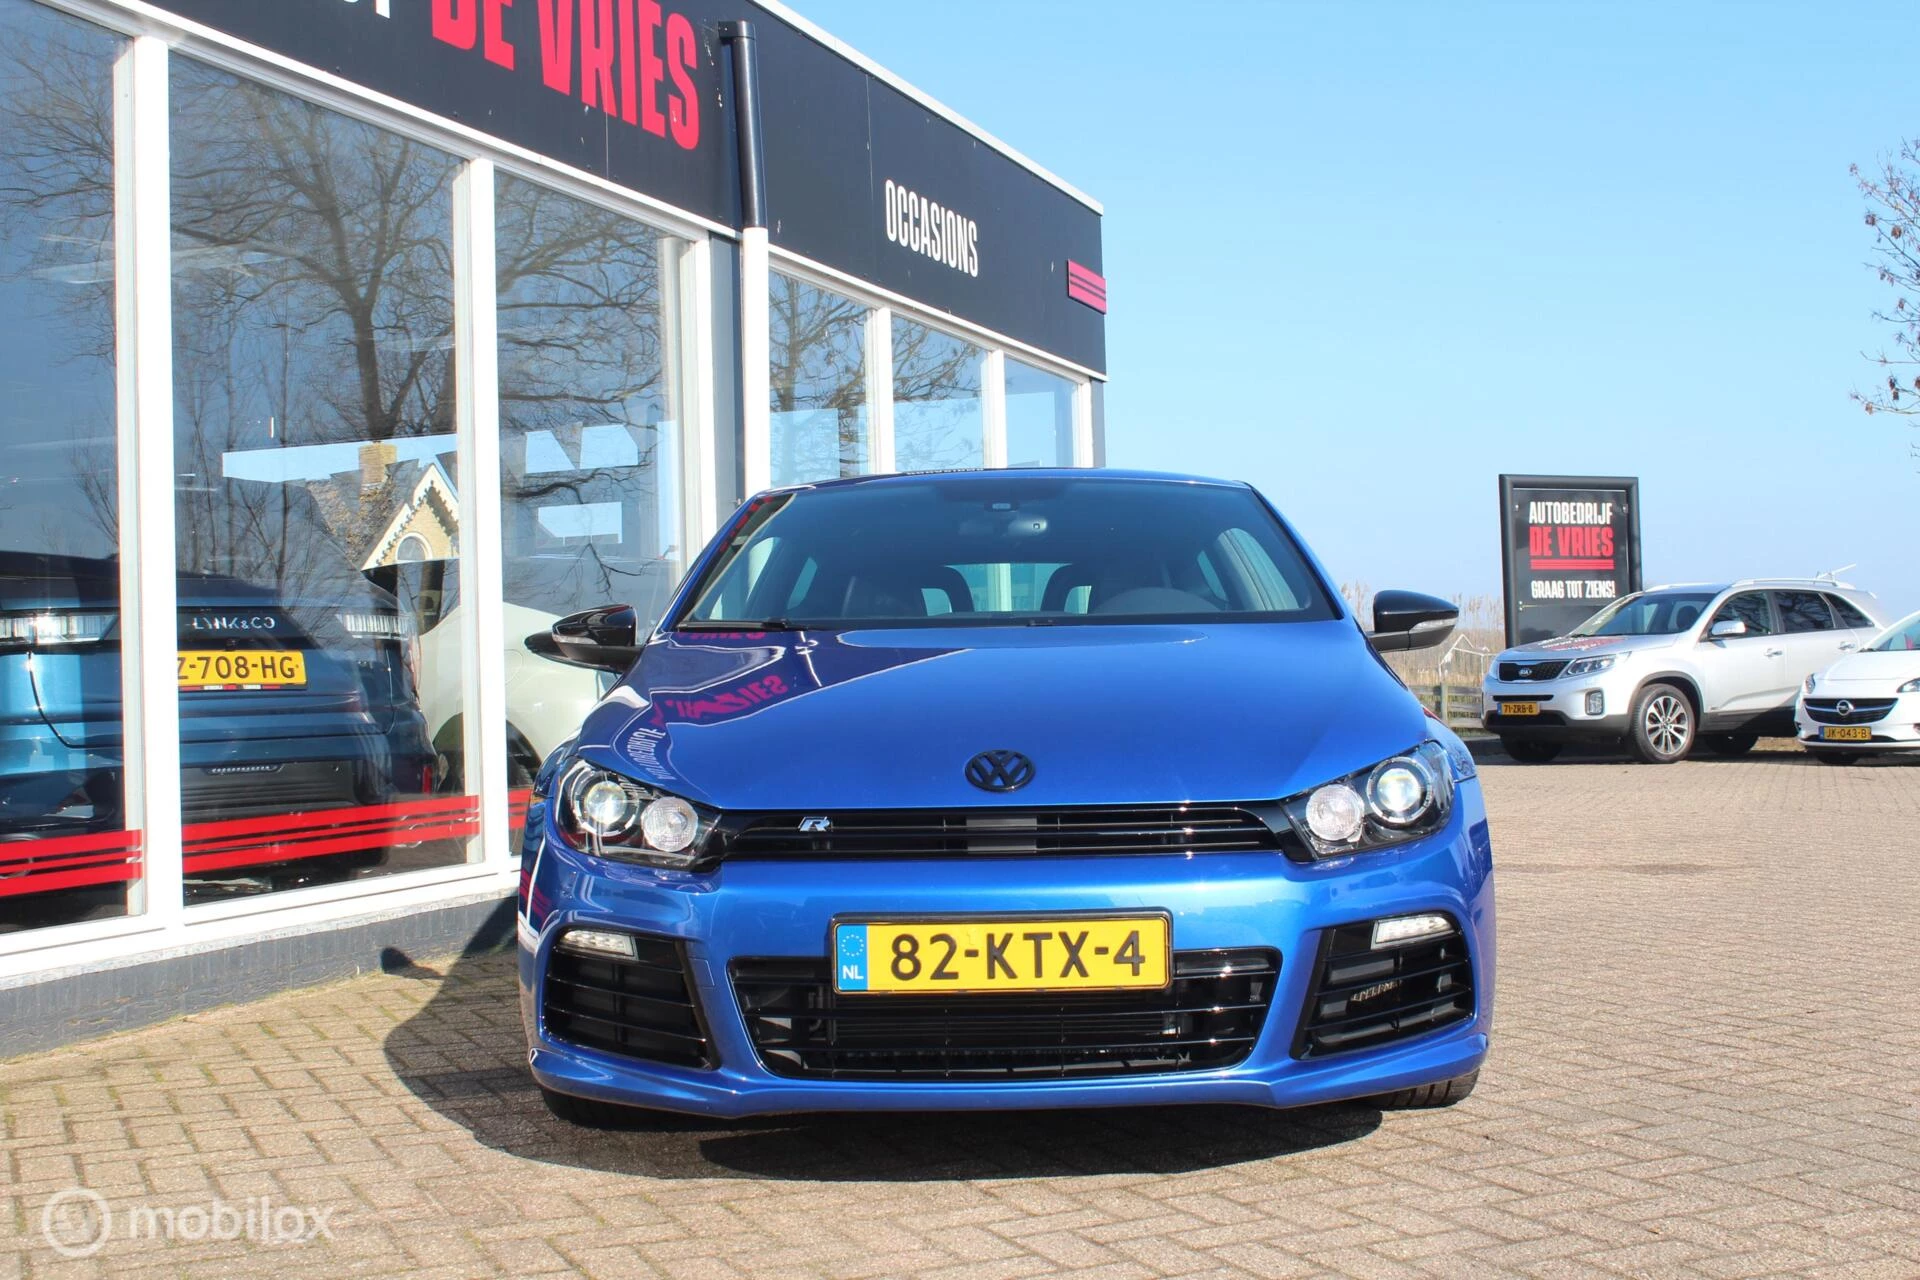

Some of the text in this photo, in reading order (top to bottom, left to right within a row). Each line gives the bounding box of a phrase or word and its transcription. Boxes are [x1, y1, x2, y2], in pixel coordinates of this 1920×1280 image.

[537, 0, 700, 150] VRIES
[885, 179, 979, 278] OCCASIONS
[1529, 501, 1613, 525] AUTOBEDRIJF
[1529, 526, 1615, 557] DE VRIES
[1531, 580, 1616, 599] GRAAG TOT ZIENS!
[178, 656, 295, 679] Z-708-HG
[1826, 727, 1867, 738] JK-043-B
[842, 930, 1146, 982] NL 82-KTX-4
